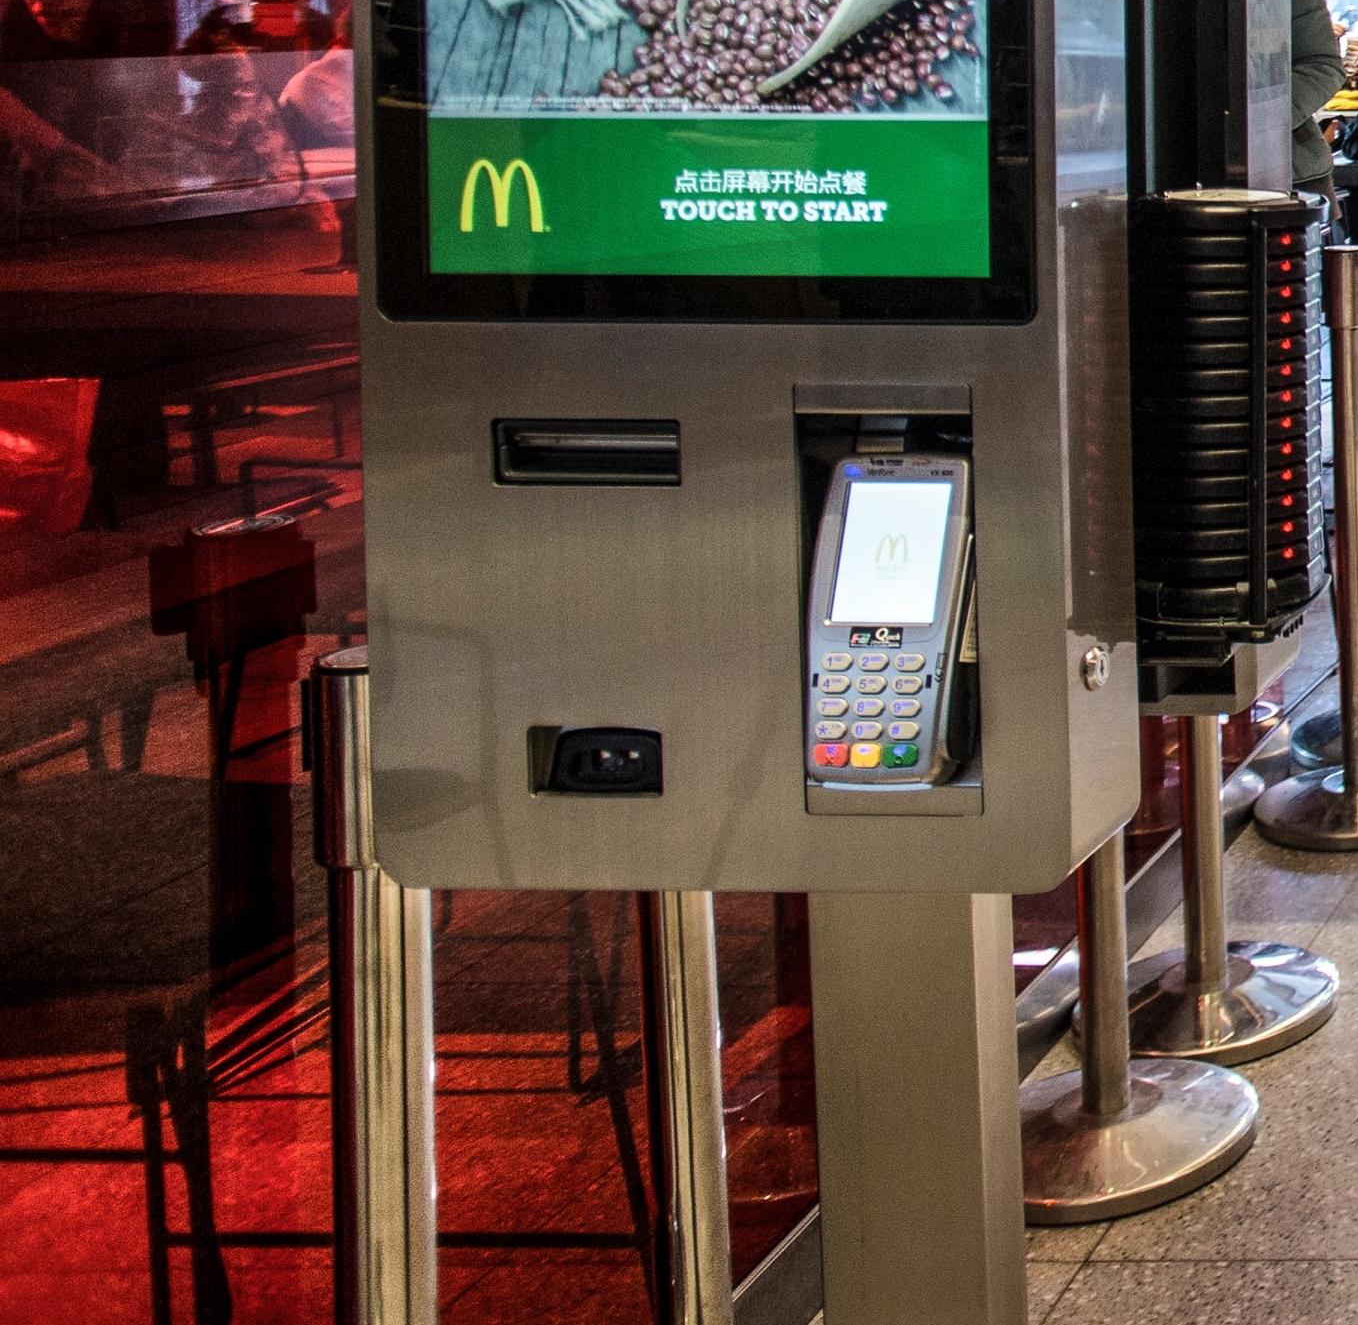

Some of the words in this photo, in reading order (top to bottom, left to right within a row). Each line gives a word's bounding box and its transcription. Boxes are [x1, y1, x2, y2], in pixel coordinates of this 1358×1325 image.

[675, 169, 867, 195] 点击屏幕开始点餐
[660, 199, 756, 222] TOUCH
[760, 199, 799, 222] TO
[803, 200, 888, 223] START
